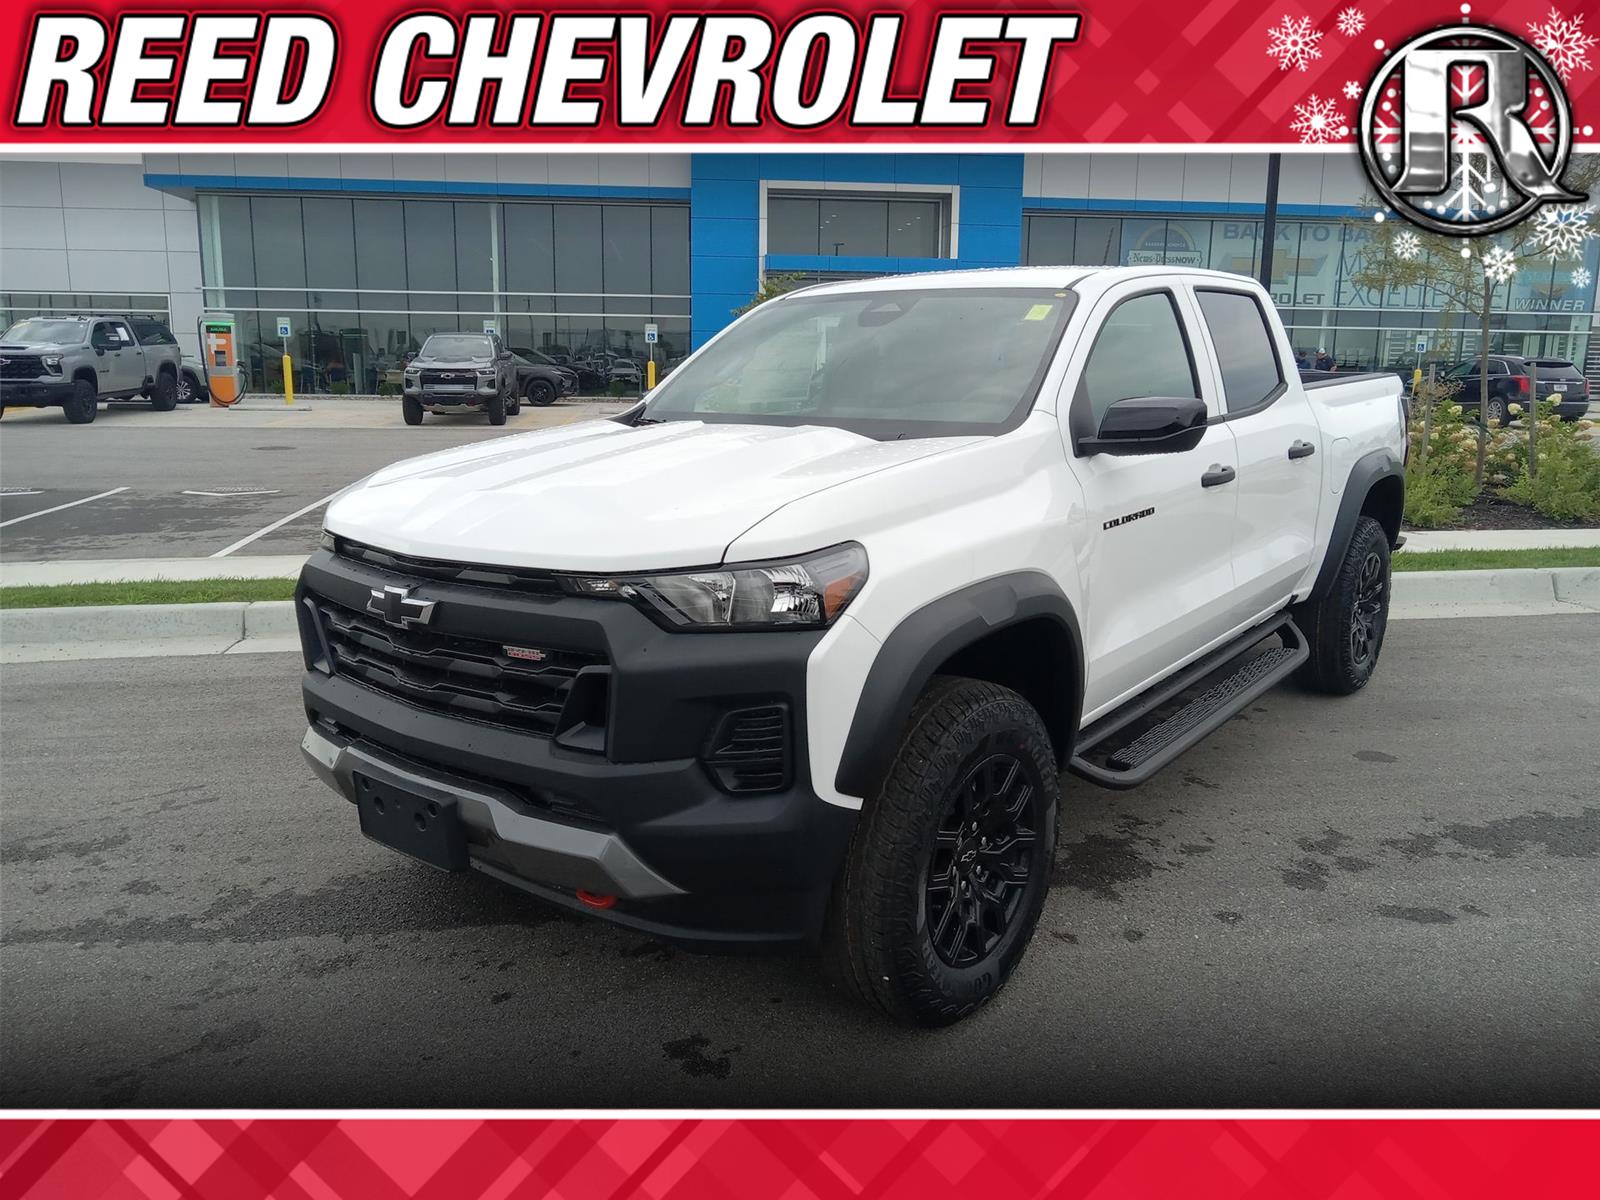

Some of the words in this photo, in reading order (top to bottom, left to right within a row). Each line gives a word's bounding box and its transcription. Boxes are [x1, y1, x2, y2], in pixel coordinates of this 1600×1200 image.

[1223, 223, 1291, 241] BAK
[1301, 225, 1331, 242] TO
[1271, 292, 1326, 306] ROLET
[1333, 279, 1503, 309] EXCELLEE
[1513, 298, 1586, 312] WINNER
[1103, 506, 1156, 531] COLORADO
